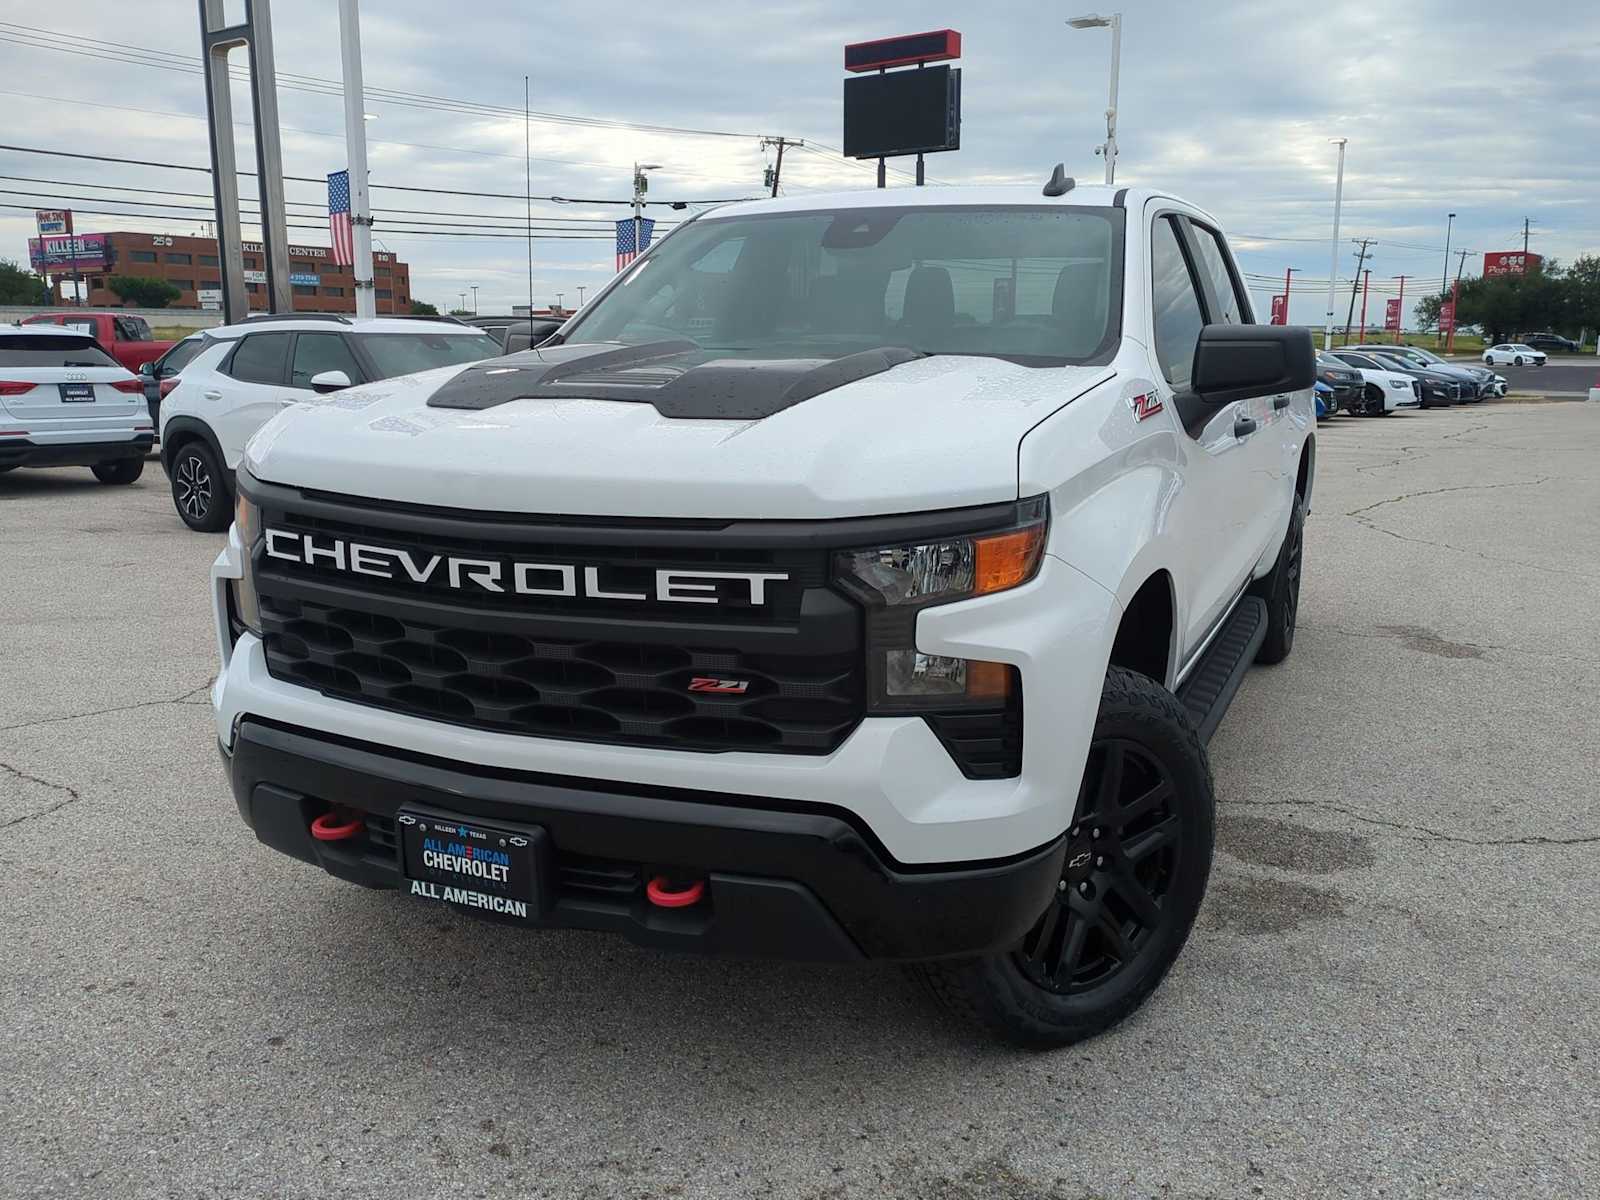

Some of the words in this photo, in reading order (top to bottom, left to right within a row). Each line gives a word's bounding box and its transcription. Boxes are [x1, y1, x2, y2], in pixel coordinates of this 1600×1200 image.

[46, 240, 85, 254] KILLEEN
[289, 247, 327, 257] CENTER
[265, 527, 789, 605] CHEVROLET
[687, 677, 750, 694] Z71
[434, 824, 456, 834] KILLEEN
[469, 831, 487, 840] TEXAS
[423, 837, 445, 853] ALL
[448, 842, 509, 866] AMERICAN
[423, 850, 510, 882] CHEVROLET
[410, 880, 440, 899] ALL
[443, 886, 527, 918] AMERICAN
